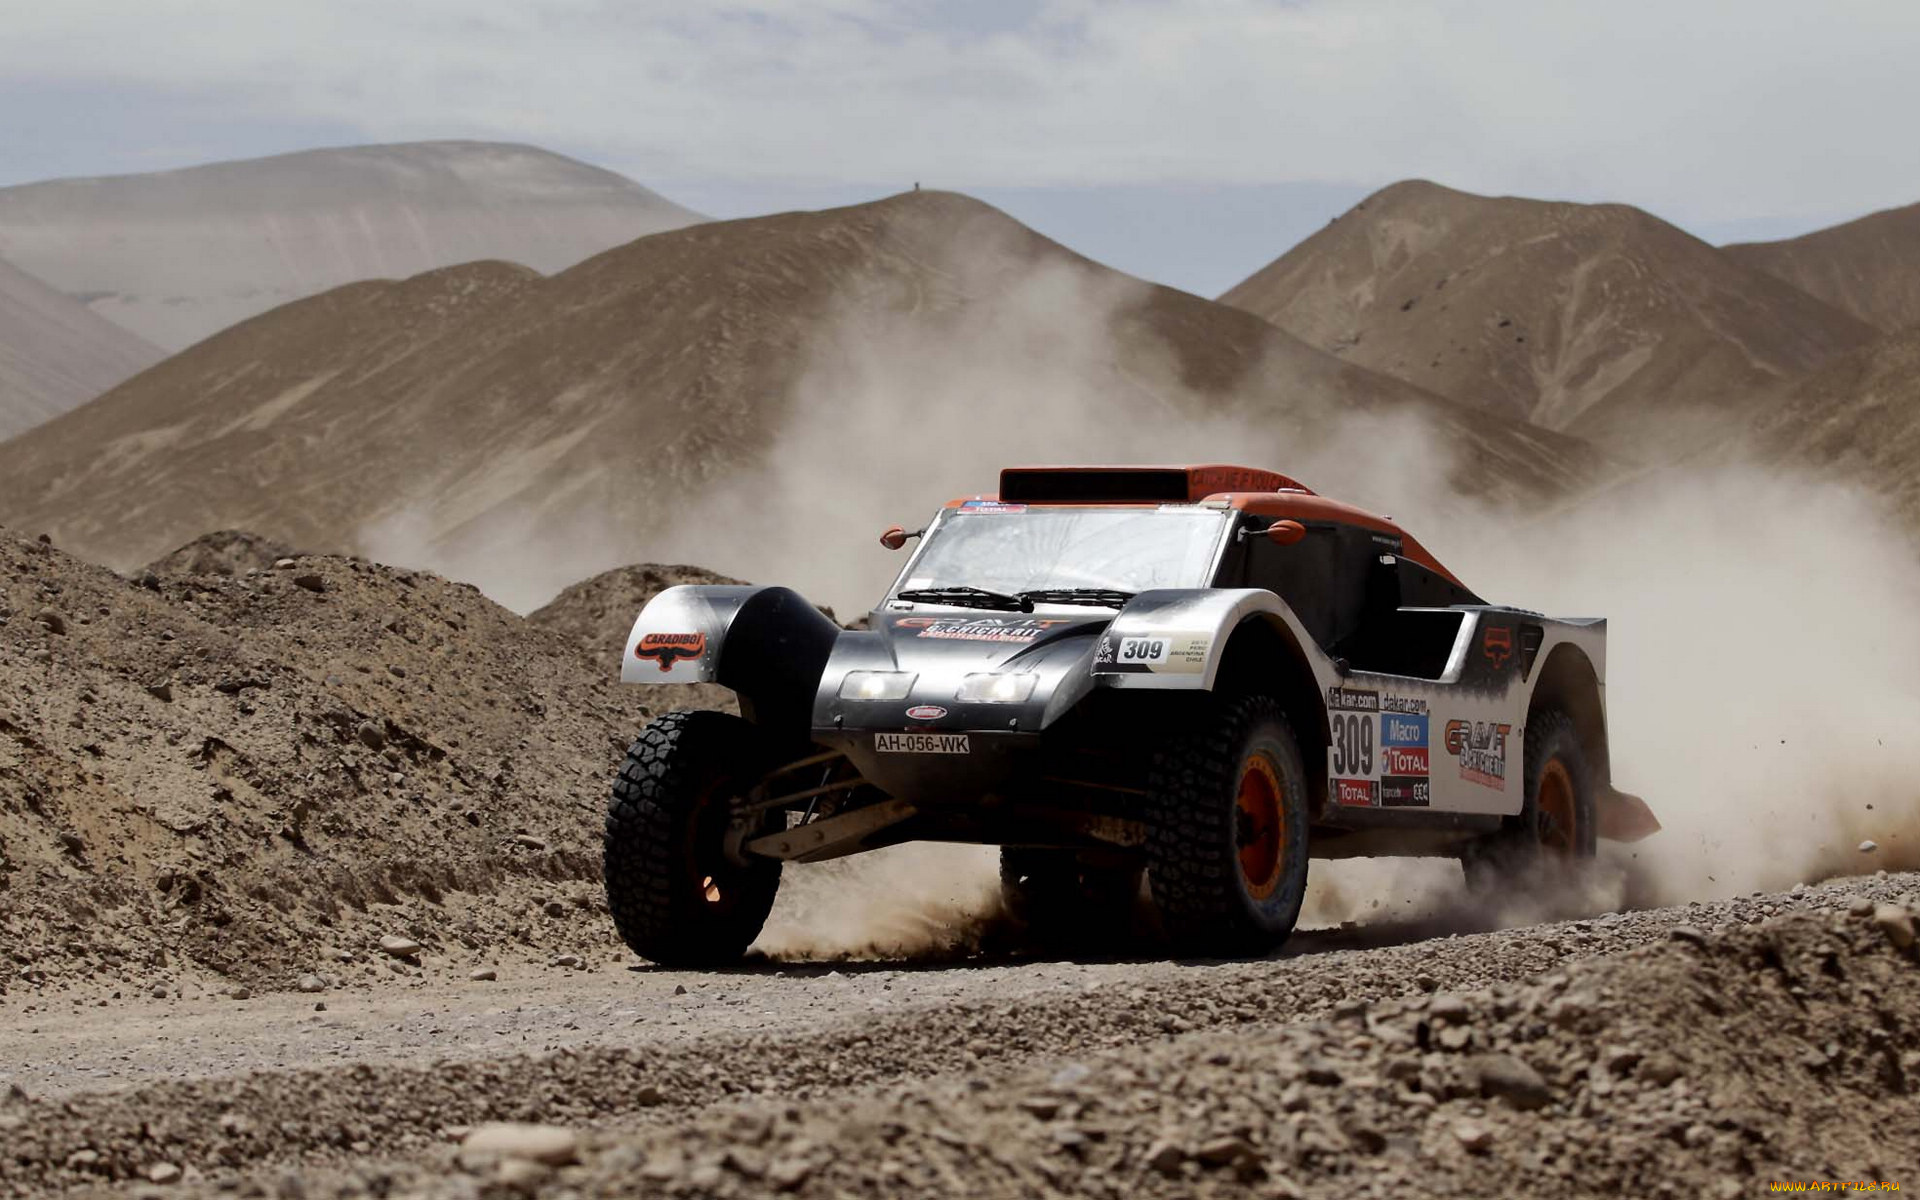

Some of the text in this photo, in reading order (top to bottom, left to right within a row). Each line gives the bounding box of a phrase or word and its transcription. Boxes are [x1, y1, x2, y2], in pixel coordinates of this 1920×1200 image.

[1123, 640, 1164, 660] 309
[1389, 719, 1420, 741] Macro
[877, 735, 969, 753] AH-056-WK
[1333, 714, 1373, 775] 309
[1391, 750, 1427, 771] TOTAL
[1340, 783, 1369, 801] TOTAL
